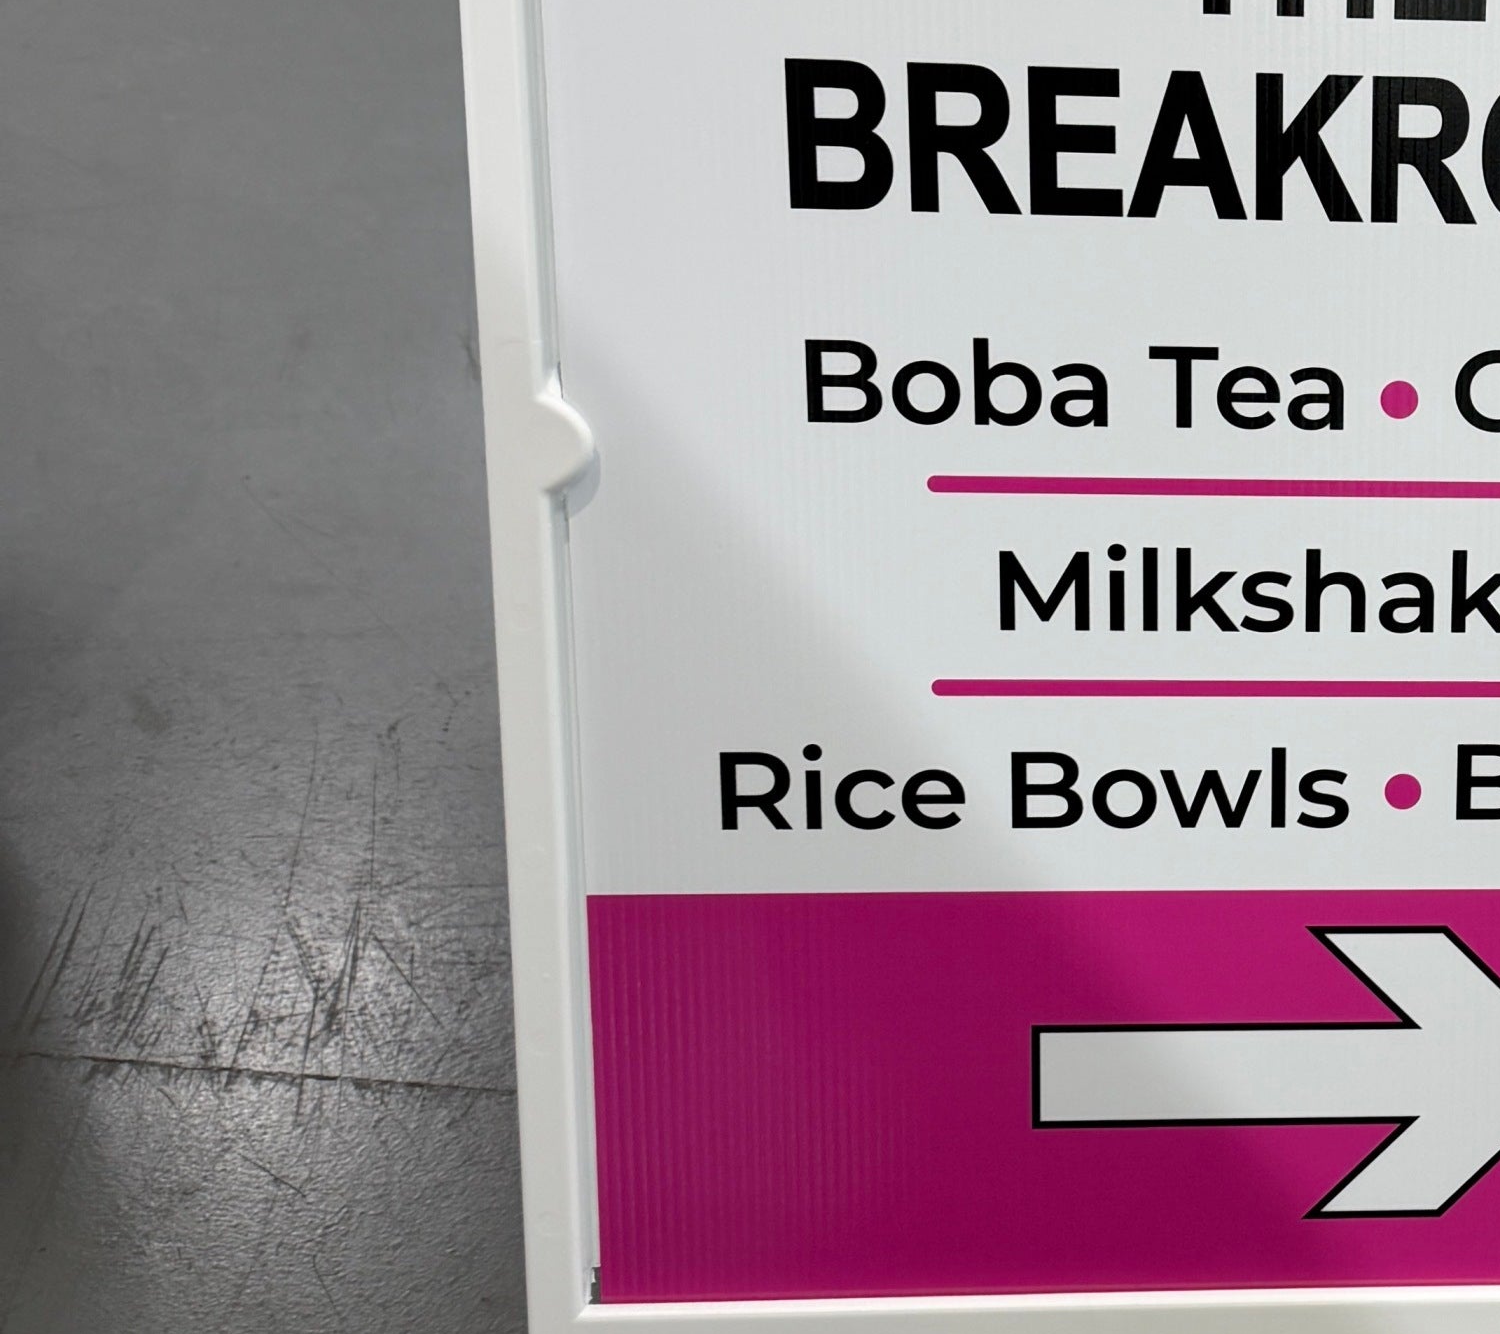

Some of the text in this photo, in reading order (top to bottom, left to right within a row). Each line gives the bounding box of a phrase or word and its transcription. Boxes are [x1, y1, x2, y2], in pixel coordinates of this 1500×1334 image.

[803, 338, 1109, 428] Boba
[1149, 346, 1346, 431] Tea
[718, 743, 966, 831] Rice
[1010, 747, 1351, 830] Bowls
